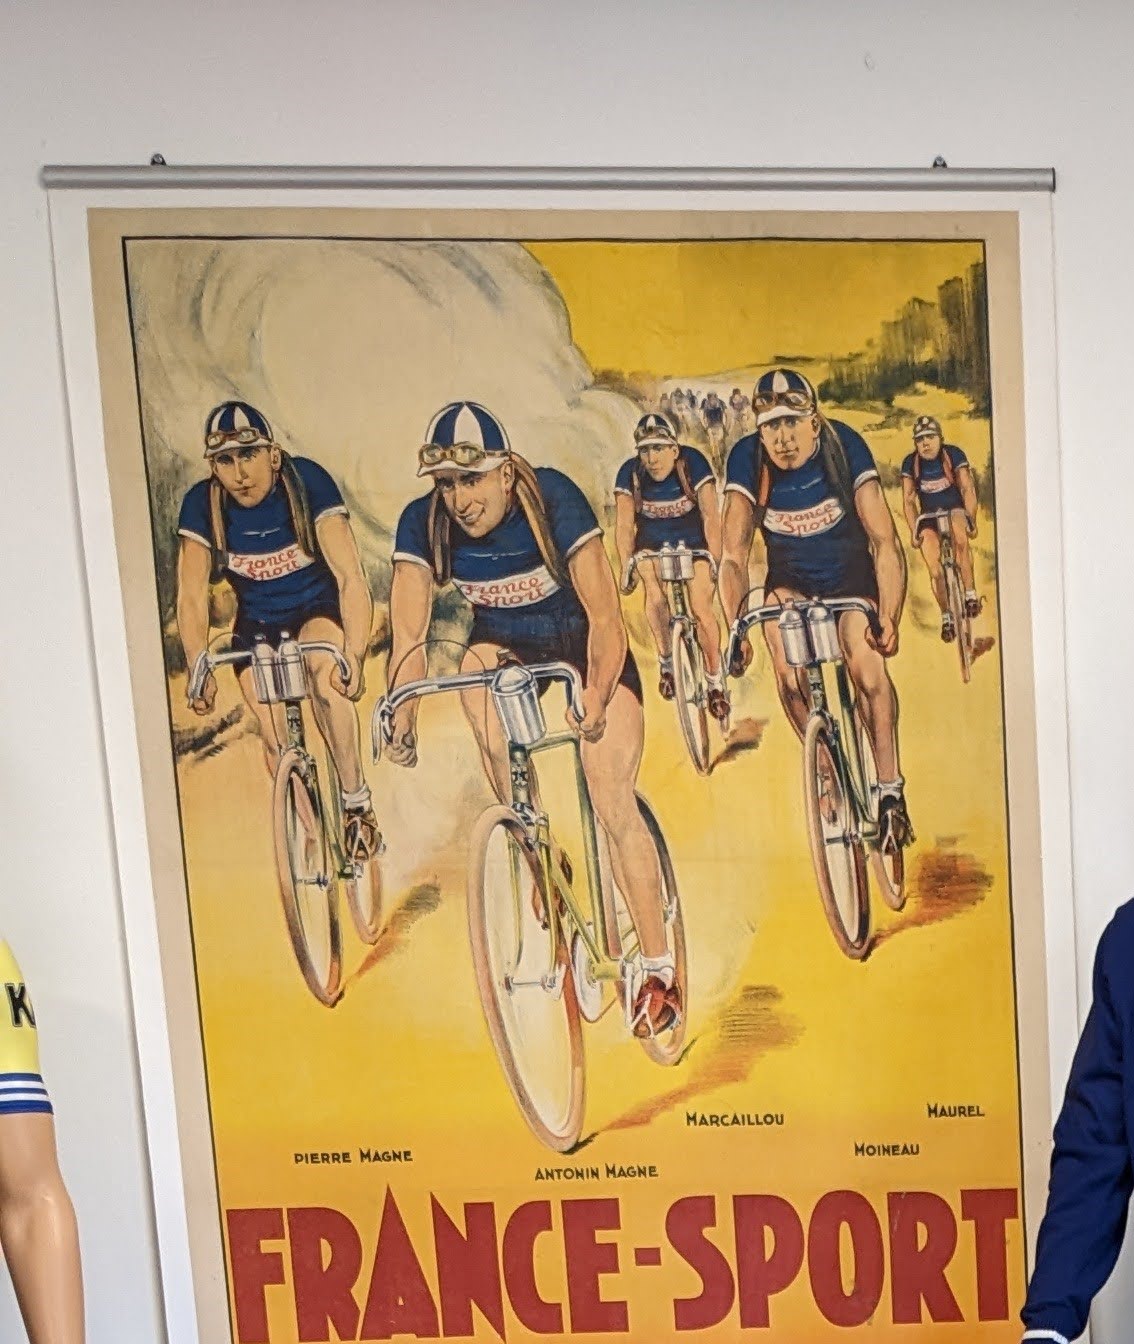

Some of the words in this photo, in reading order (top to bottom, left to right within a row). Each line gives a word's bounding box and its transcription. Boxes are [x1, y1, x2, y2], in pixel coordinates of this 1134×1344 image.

[927, 1103, 985, 1118] MAUREL
[686, 1112, 785, 1127] MARCAILLOU
[294, 1152, 352, 1164] PIERRE
[358, 1149, 414, 1164] MAGNE
[854, 1142, 920, 1156] MOINEAU
[535, 1166, 600, 1181] ANTONIN
[605, 1163, 659, 1179] MAGNE
[225, 1184, 1019, 1344] FRANCE-SPORT
